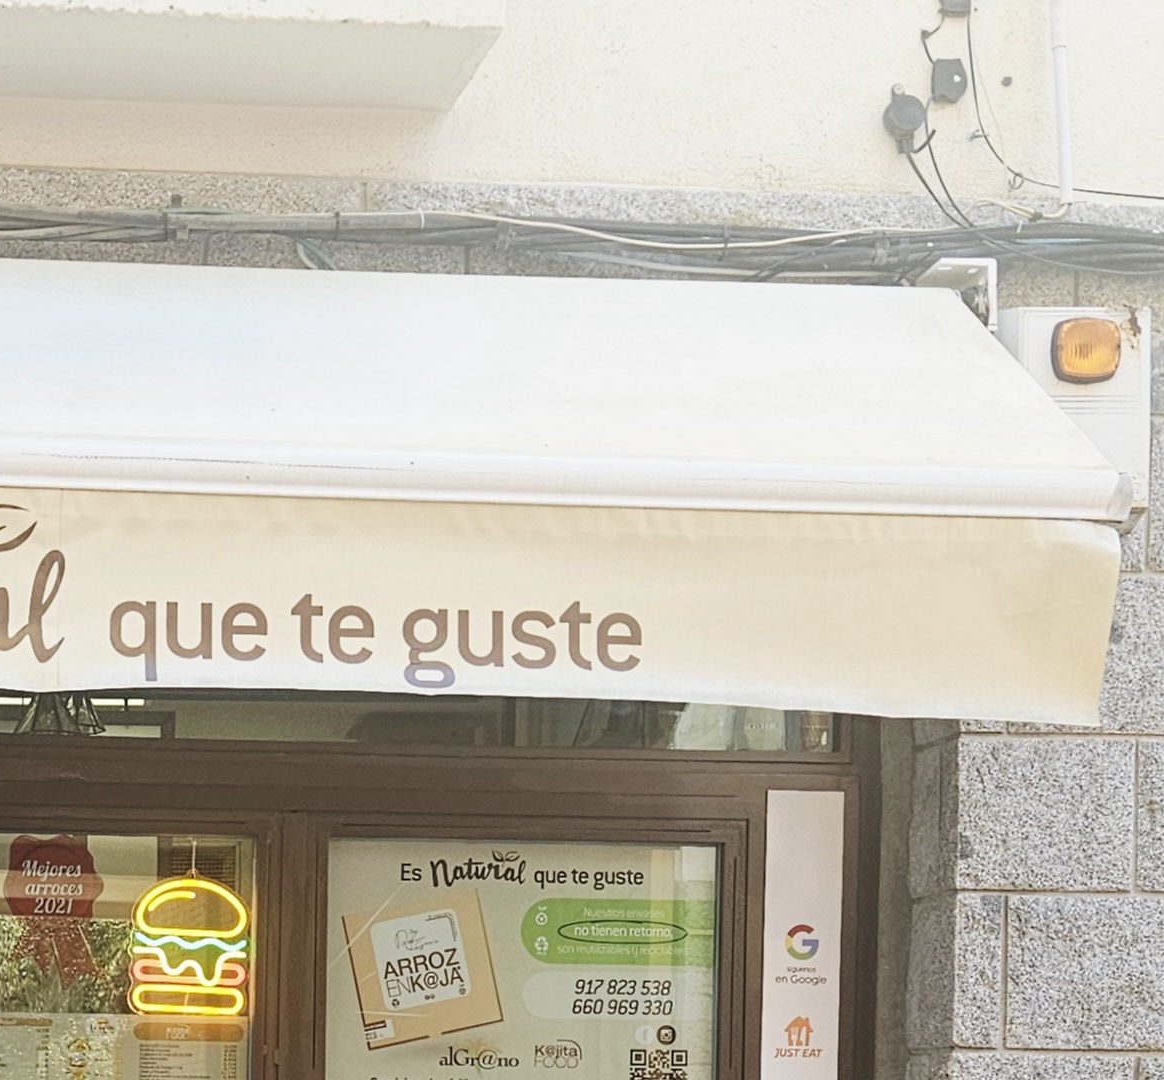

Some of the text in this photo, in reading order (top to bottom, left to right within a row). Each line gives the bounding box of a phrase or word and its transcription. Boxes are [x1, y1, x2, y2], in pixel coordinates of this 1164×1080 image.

[110, 600, 268, 681] que
[291, 594, 375, 663] te
[403, 601, 642, 688] guste
[22, 860, 81, 881] Mejores
[401, 858, 644, 890] Es Natural que te guste
[25, 884, 83, 895] arroces
[34, 898, 73, 914] 2021
[584, 908, 624, 917] Nuestros
[574, 924, 673, 939] no tienen retorno,
[384, 948, 460, 980] ARROZ
[575, 979, 671, 996] 917 823 538
[790, 975, 827, 986] Google
[572, 999, 673, 1015] 660 969 330
[774, 1049, 822, 1058] JUST EAT
[534, 1056, 578, 1068] FOOD
